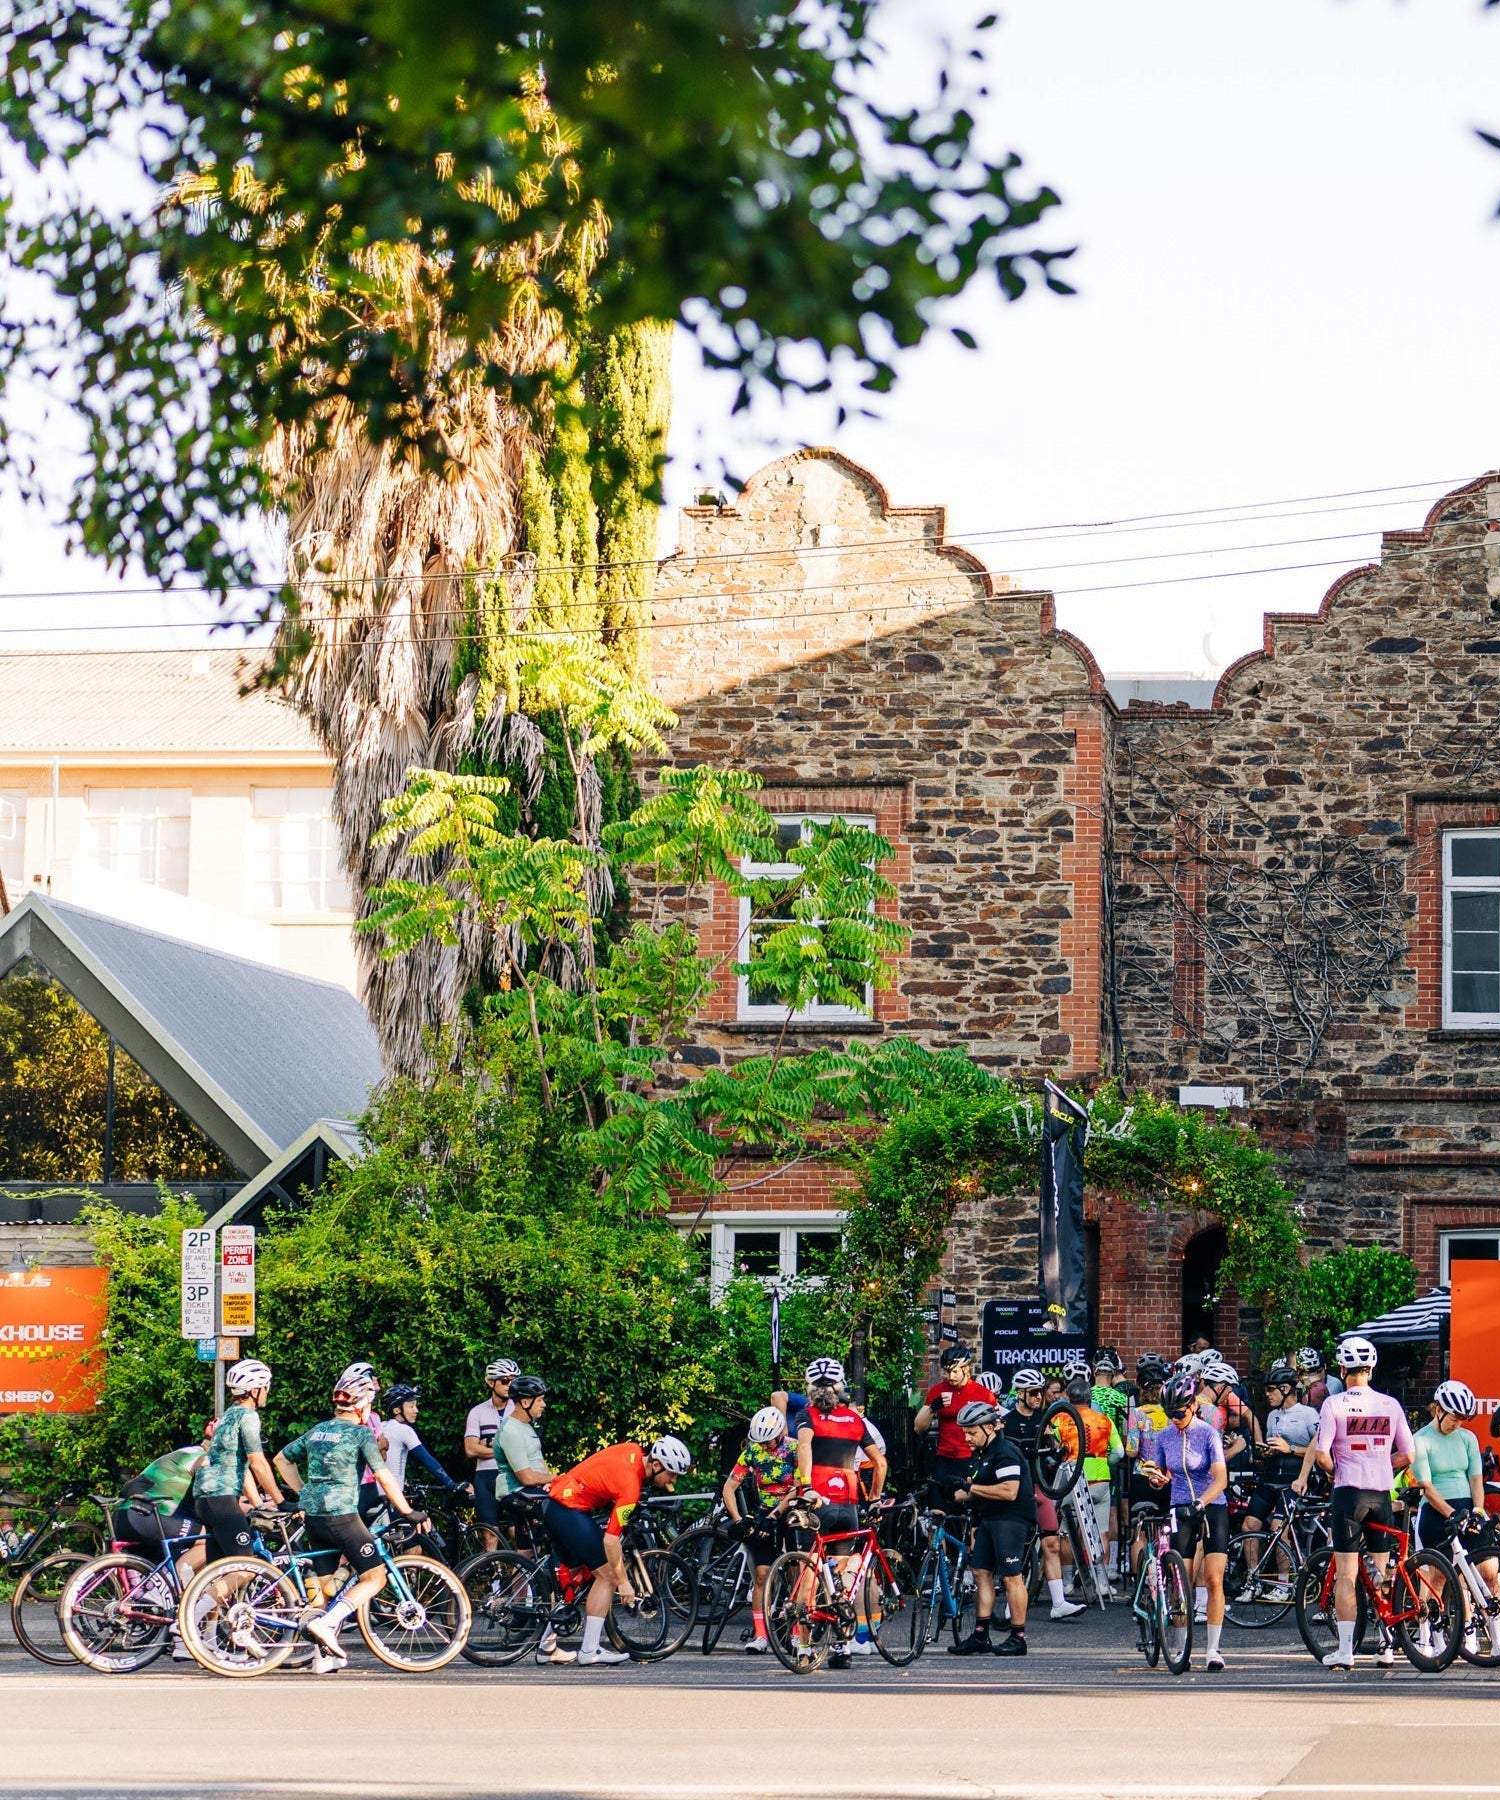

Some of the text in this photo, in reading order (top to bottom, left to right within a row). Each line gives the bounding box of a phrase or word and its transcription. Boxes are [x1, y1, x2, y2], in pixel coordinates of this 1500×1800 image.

[188, 1232, 211, 1247] 2P
[224, 1246, 252, 1255] PERMIT
[227, 1256, 248, 1264] ZONE
[187, 1286, 208, 1301] 3P
[994, 1349, 1086, 1364] TRACKHOUSE
[5, 1390, 41, 1402] SHEEP
[1348, 1419, 1390, 1431] MAAP
[218, 1563, 268, 1575] roval
